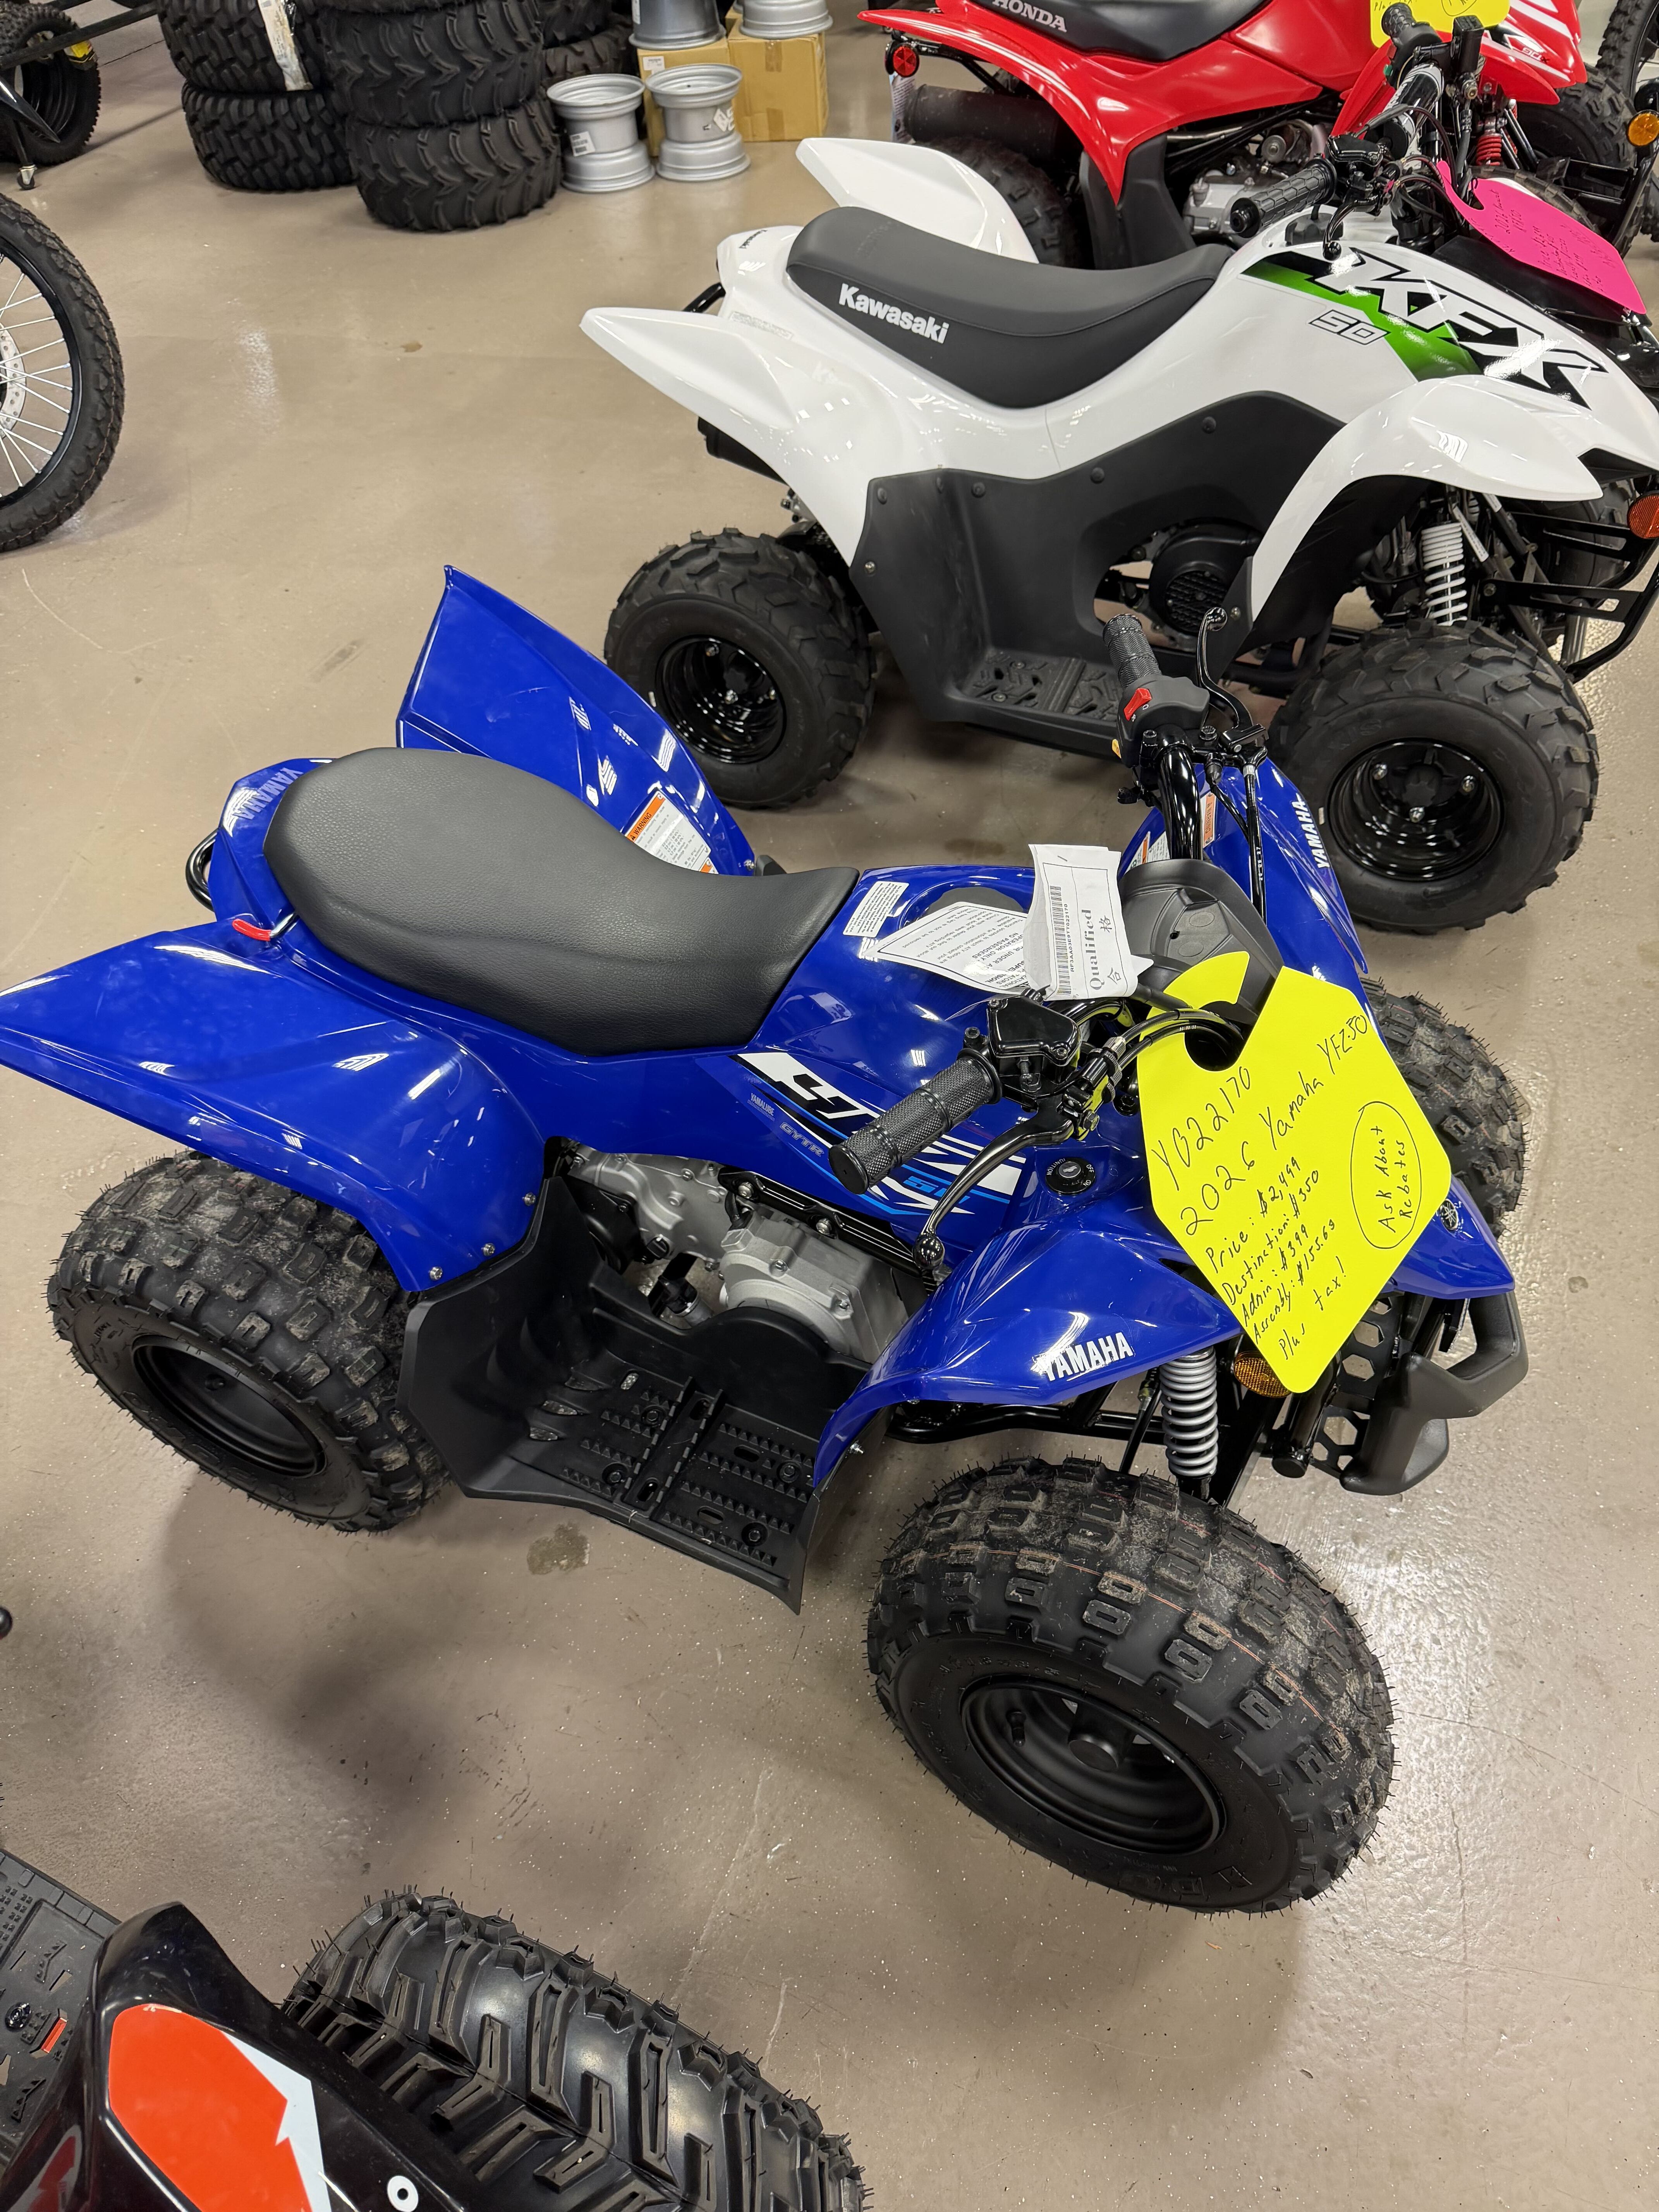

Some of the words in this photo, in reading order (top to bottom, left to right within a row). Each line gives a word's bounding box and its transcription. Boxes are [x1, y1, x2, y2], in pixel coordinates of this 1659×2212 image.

[838, 283, 950, 344] Kawasaki
[1308, 309, 1391, 345] 50
[232, 767, 304, 820] YAMAHA
[634, 812, 652, 835] WARNING
[1291, 792, 1330, 868] YAMAHA
[993, 951, 1014, 964] UNDER
[1081, 909, 1105, 990] Qualified
[750, 1092, 775, 1116] YAMALUBE
[779, 1121, 825, 1157] GYTR
[1180, 1141, 1256, 1236] 2026
[1258, 1071, 1324, 1151] Yamaha
[1370, 1126, 1390, 1177] About
[1046, 1158, 1066, 1176] IGNITION
[1086, 1164, 1094, 1173] OFF
[1257, 1156, 1301, 1218] $2,499
[1394, 1140, 1413, 1219] Rebates
[1289, 1170, 1319, 1219] $350
[1279, 1224, 1309, 1271] $399
[1298, 1219, 1335, 1286] $155.63
[1279, 1323, 1305, 1360] Plus
[1313, 1255, 1347, 1311] tax!
[1034, 1332, 1134, 1381] YAMAHA
